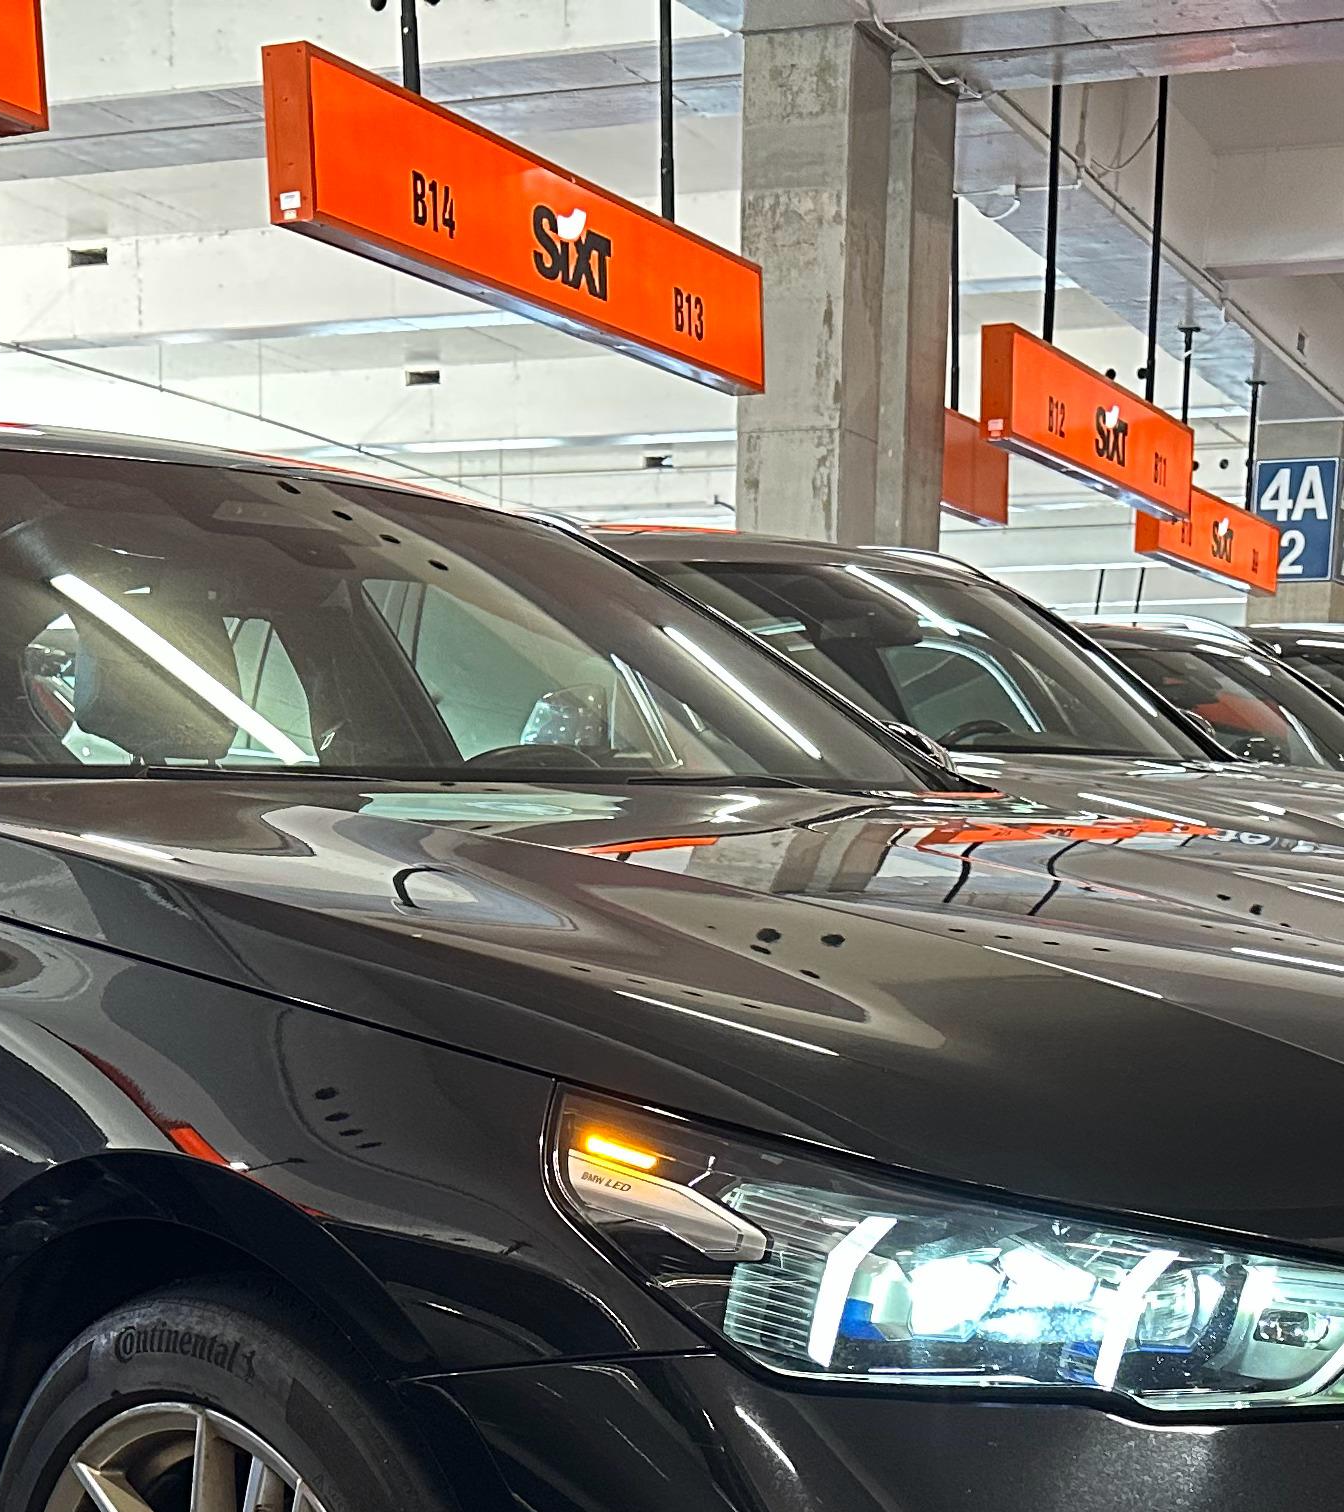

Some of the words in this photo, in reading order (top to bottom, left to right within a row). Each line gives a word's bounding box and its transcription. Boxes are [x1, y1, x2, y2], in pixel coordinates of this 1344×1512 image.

[412, 170, 456, 239] B14
[673, 287, 704, 341] B13
[1048, 395, 1065, 438] B12
[1260, 465, 1328, 522] 4A
[1277, 530, 1306, 575] 2
[581, 1171, 605, 1185] BMW
[604, 1179, 632, 1192] LED
[114, 1321, 241, 1373] Continental
